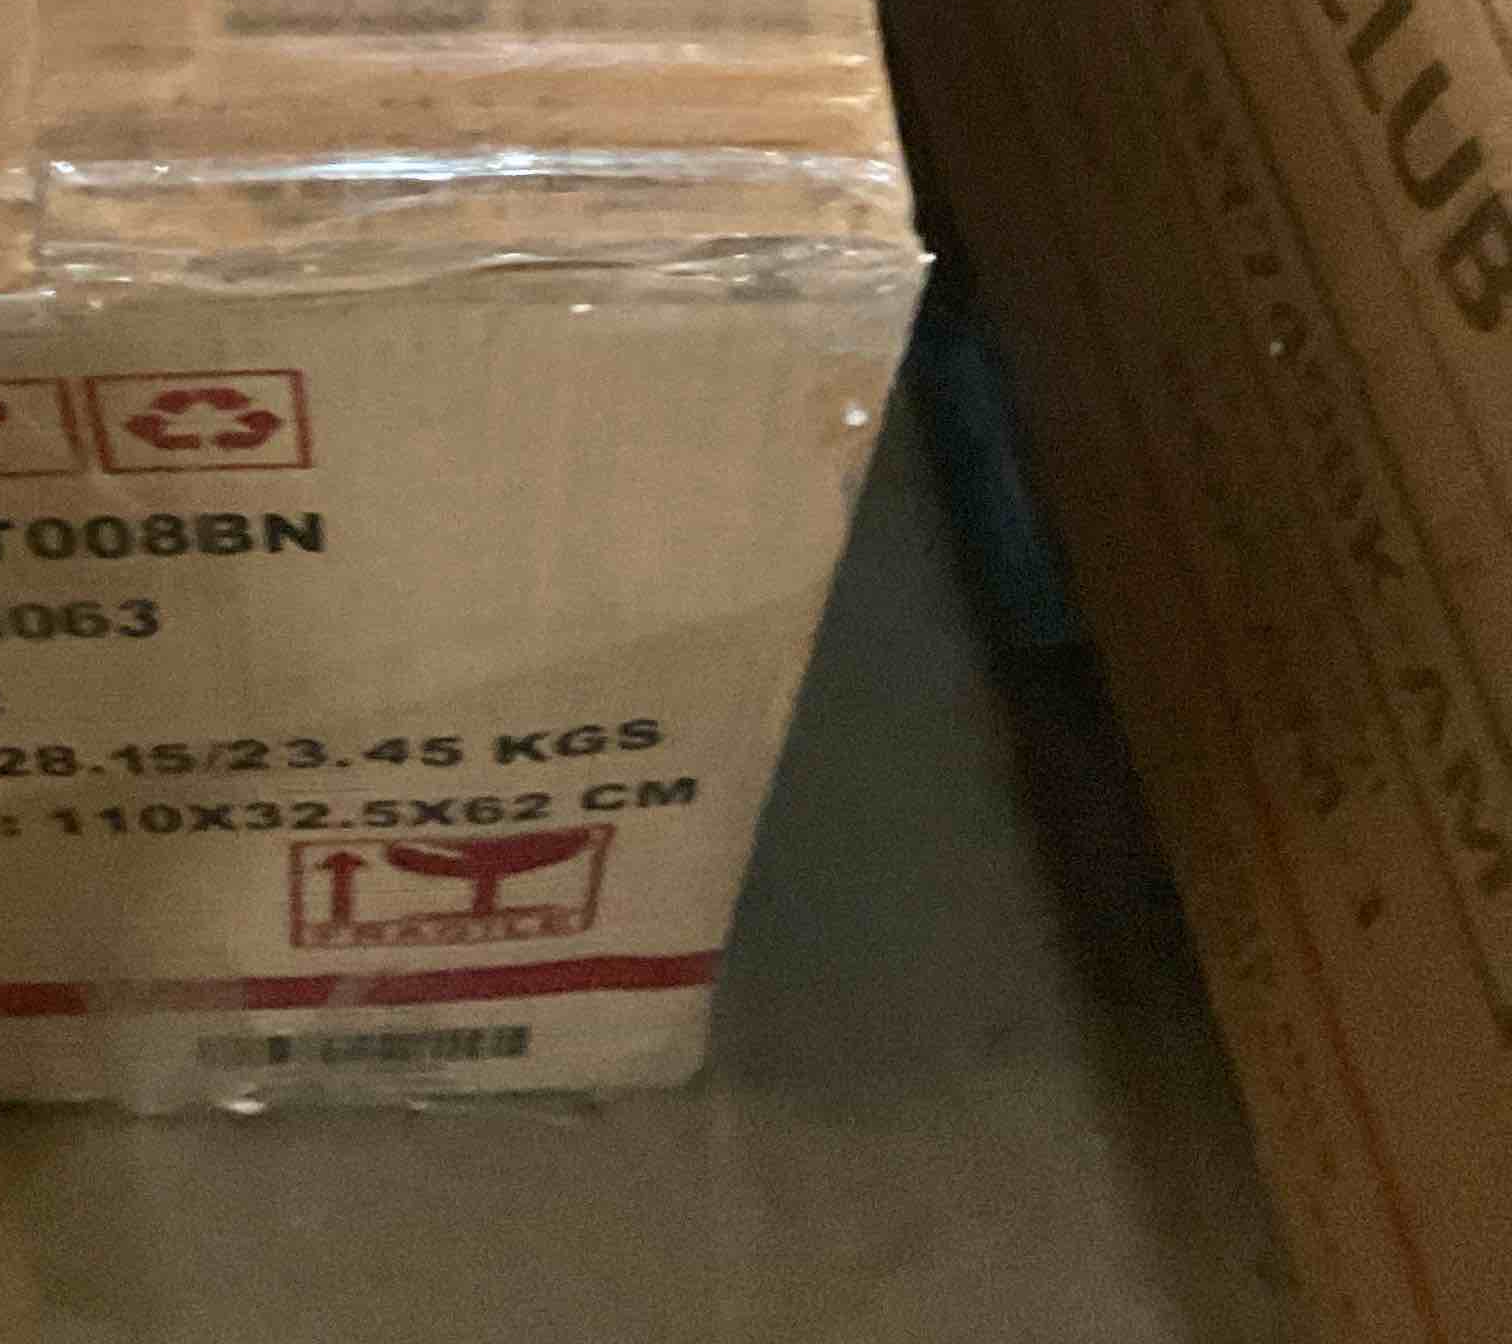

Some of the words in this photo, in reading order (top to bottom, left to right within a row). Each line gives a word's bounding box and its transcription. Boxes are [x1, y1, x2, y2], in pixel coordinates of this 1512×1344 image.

[492, 717, 665, 768] KGS
[51, 791, 554, 840] 110X32.5X62
[578, 774, 700, 813] CM
